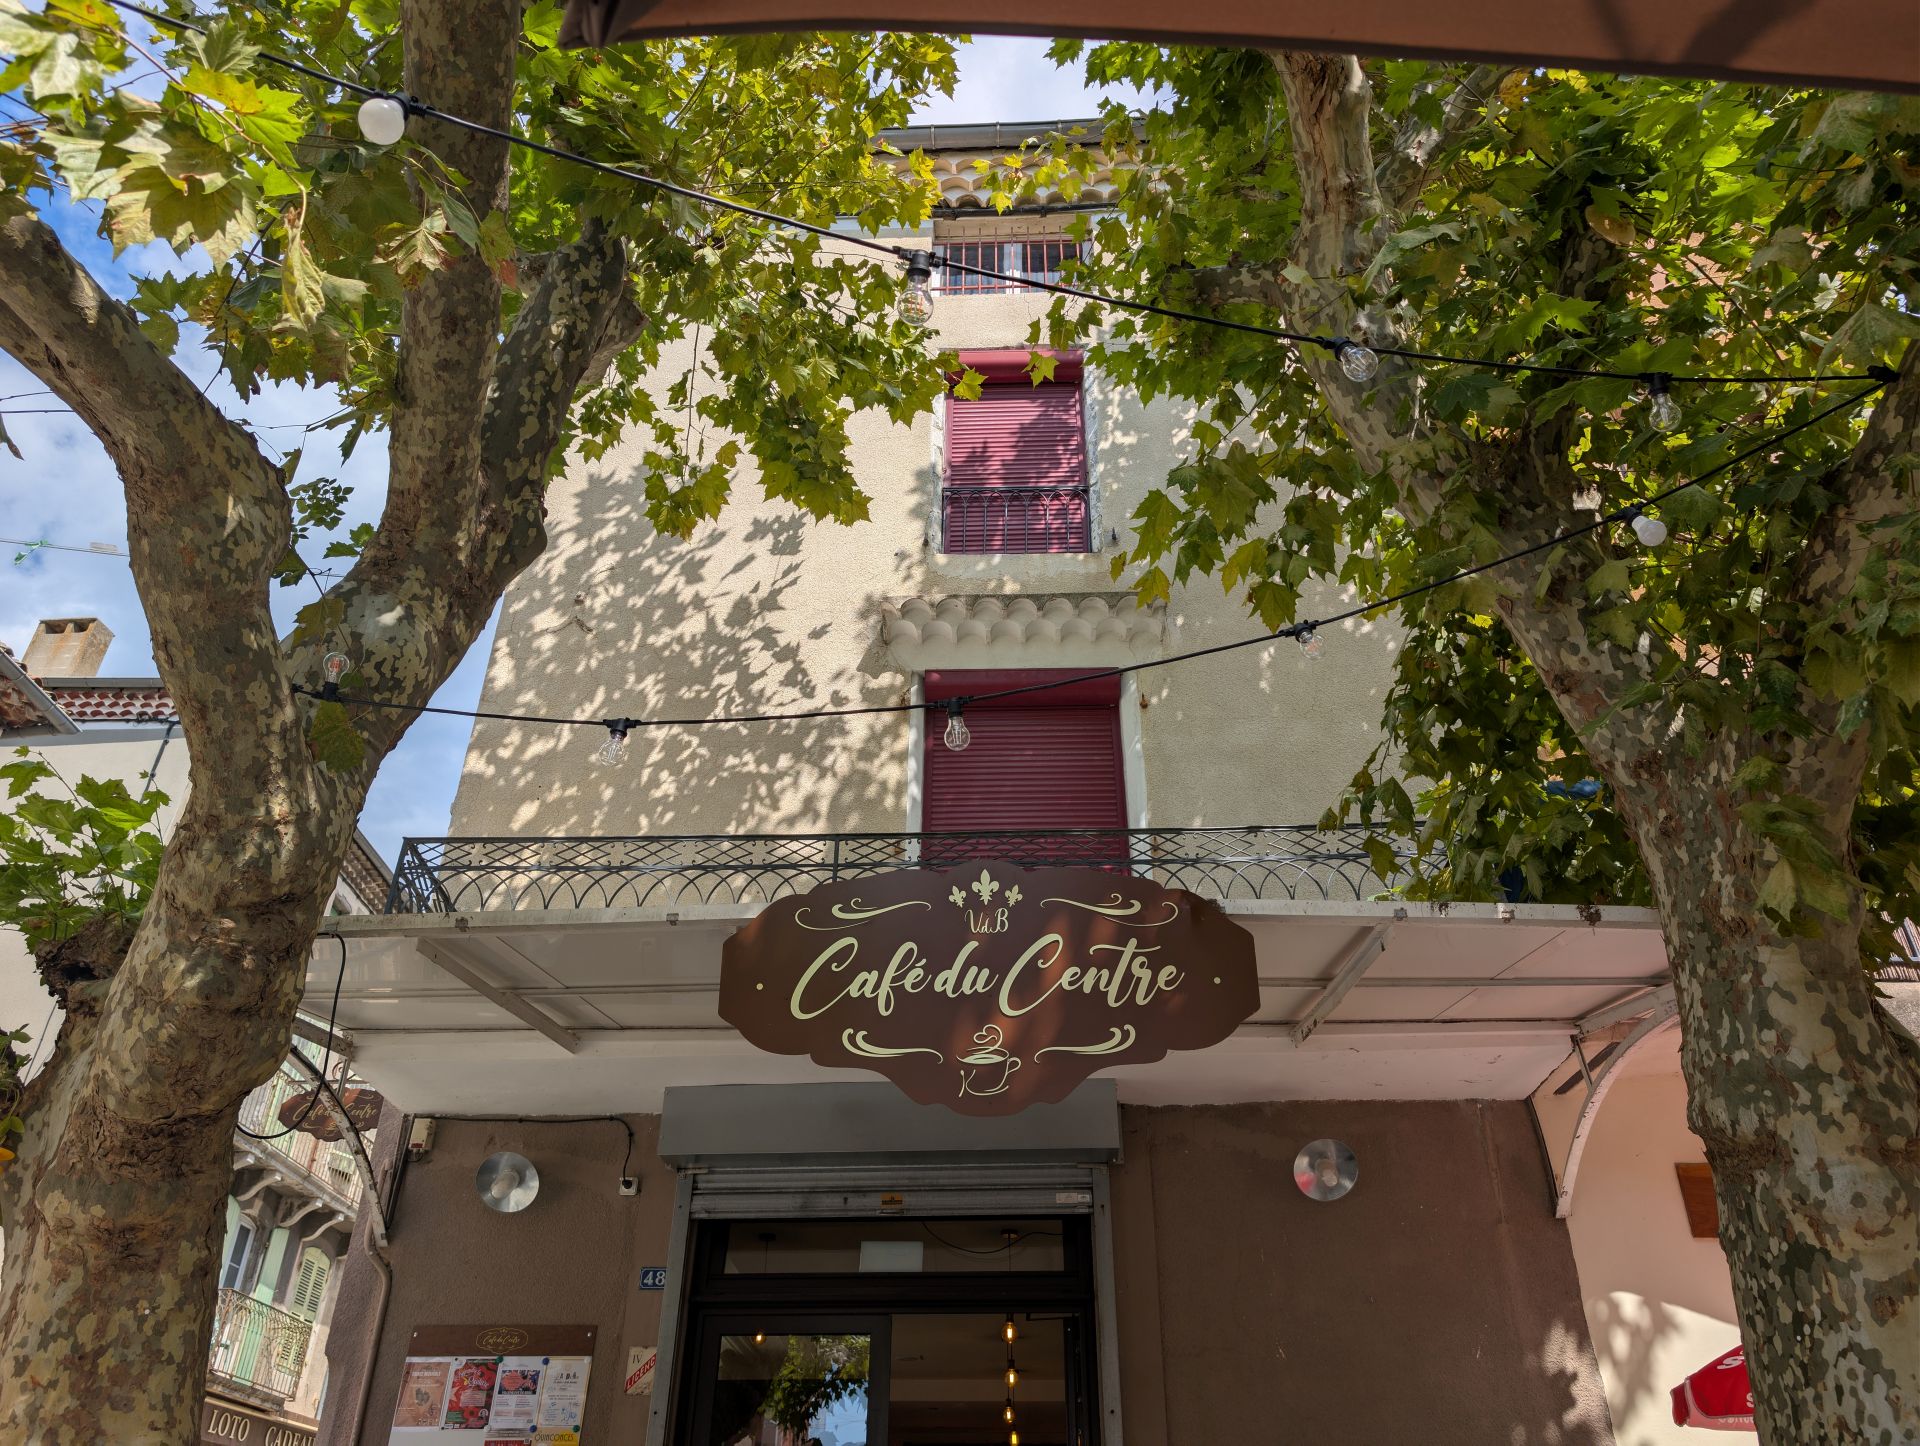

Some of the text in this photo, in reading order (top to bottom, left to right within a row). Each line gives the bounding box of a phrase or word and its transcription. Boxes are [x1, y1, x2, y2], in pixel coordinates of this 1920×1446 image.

[790, 933, 1185, 1020] Café du Centre
[643, 1271, 665, 1286] 48
[626, 1355, 656, 1389] LICENC
[208, 1410, 250, 1442] LOTO
